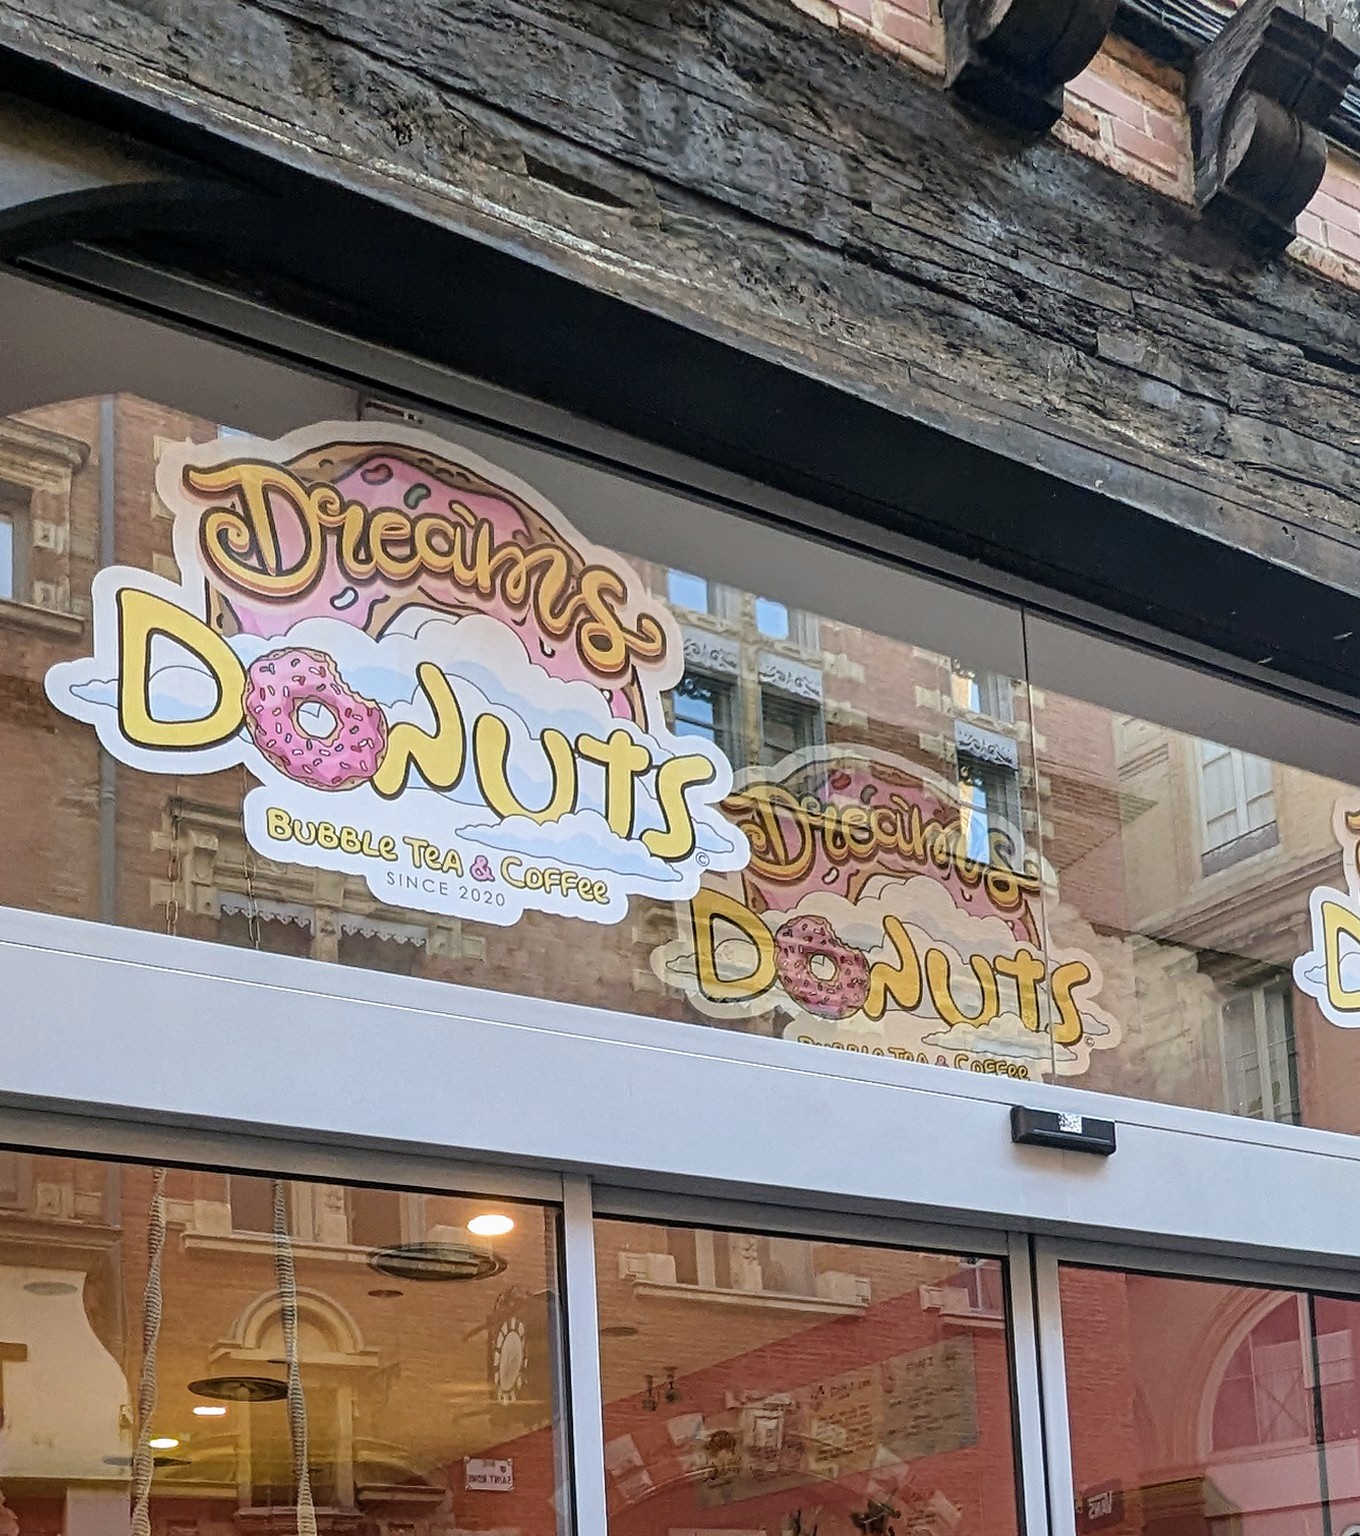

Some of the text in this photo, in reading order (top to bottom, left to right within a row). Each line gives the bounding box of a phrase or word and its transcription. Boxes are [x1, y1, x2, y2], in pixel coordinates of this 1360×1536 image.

[183, 458, 668, 675] Dreams
[115, 588, 716, 863] DONUTS
[386, 870, 506, 908] SINCE 2020
[469, 854, 495, 883] &
[721, 782, 1044, 911] Dreams
[690, 886, 1091, 1047] DONUTS
